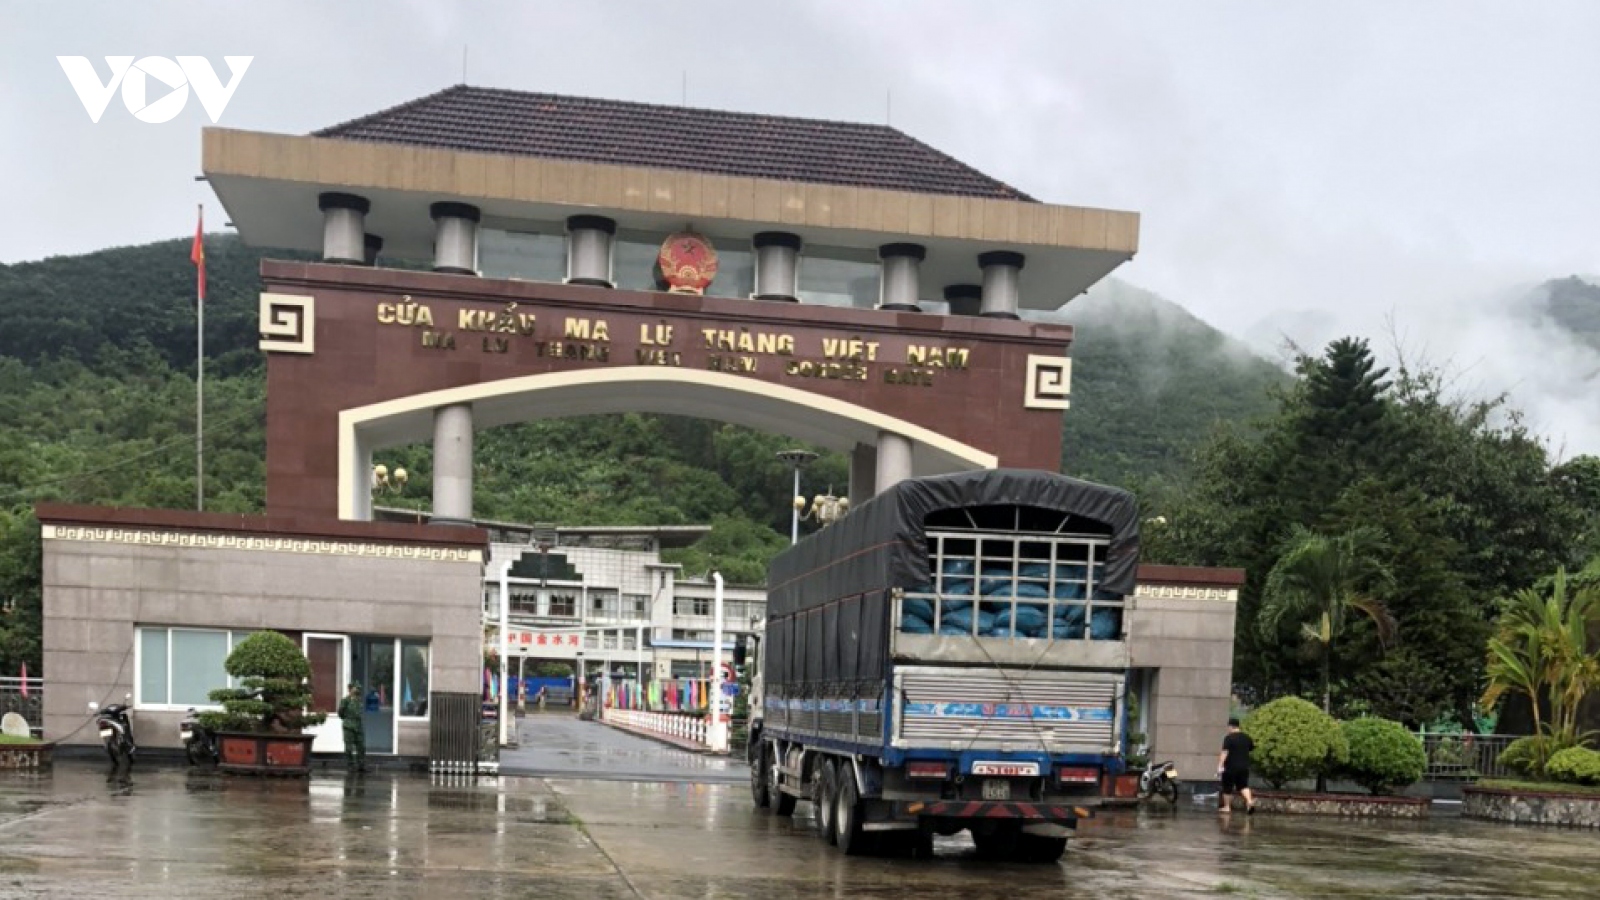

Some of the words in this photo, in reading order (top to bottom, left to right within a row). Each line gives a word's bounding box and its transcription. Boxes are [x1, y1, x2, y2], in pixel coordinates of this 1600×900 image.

[377, 295, 434, 326] CỬA
[565, 317, 610, 341] MA
[907, 344, 970, 370] NAM
[422, 331, 456, 351] MA
[535, 341, 610, 363] THANG
